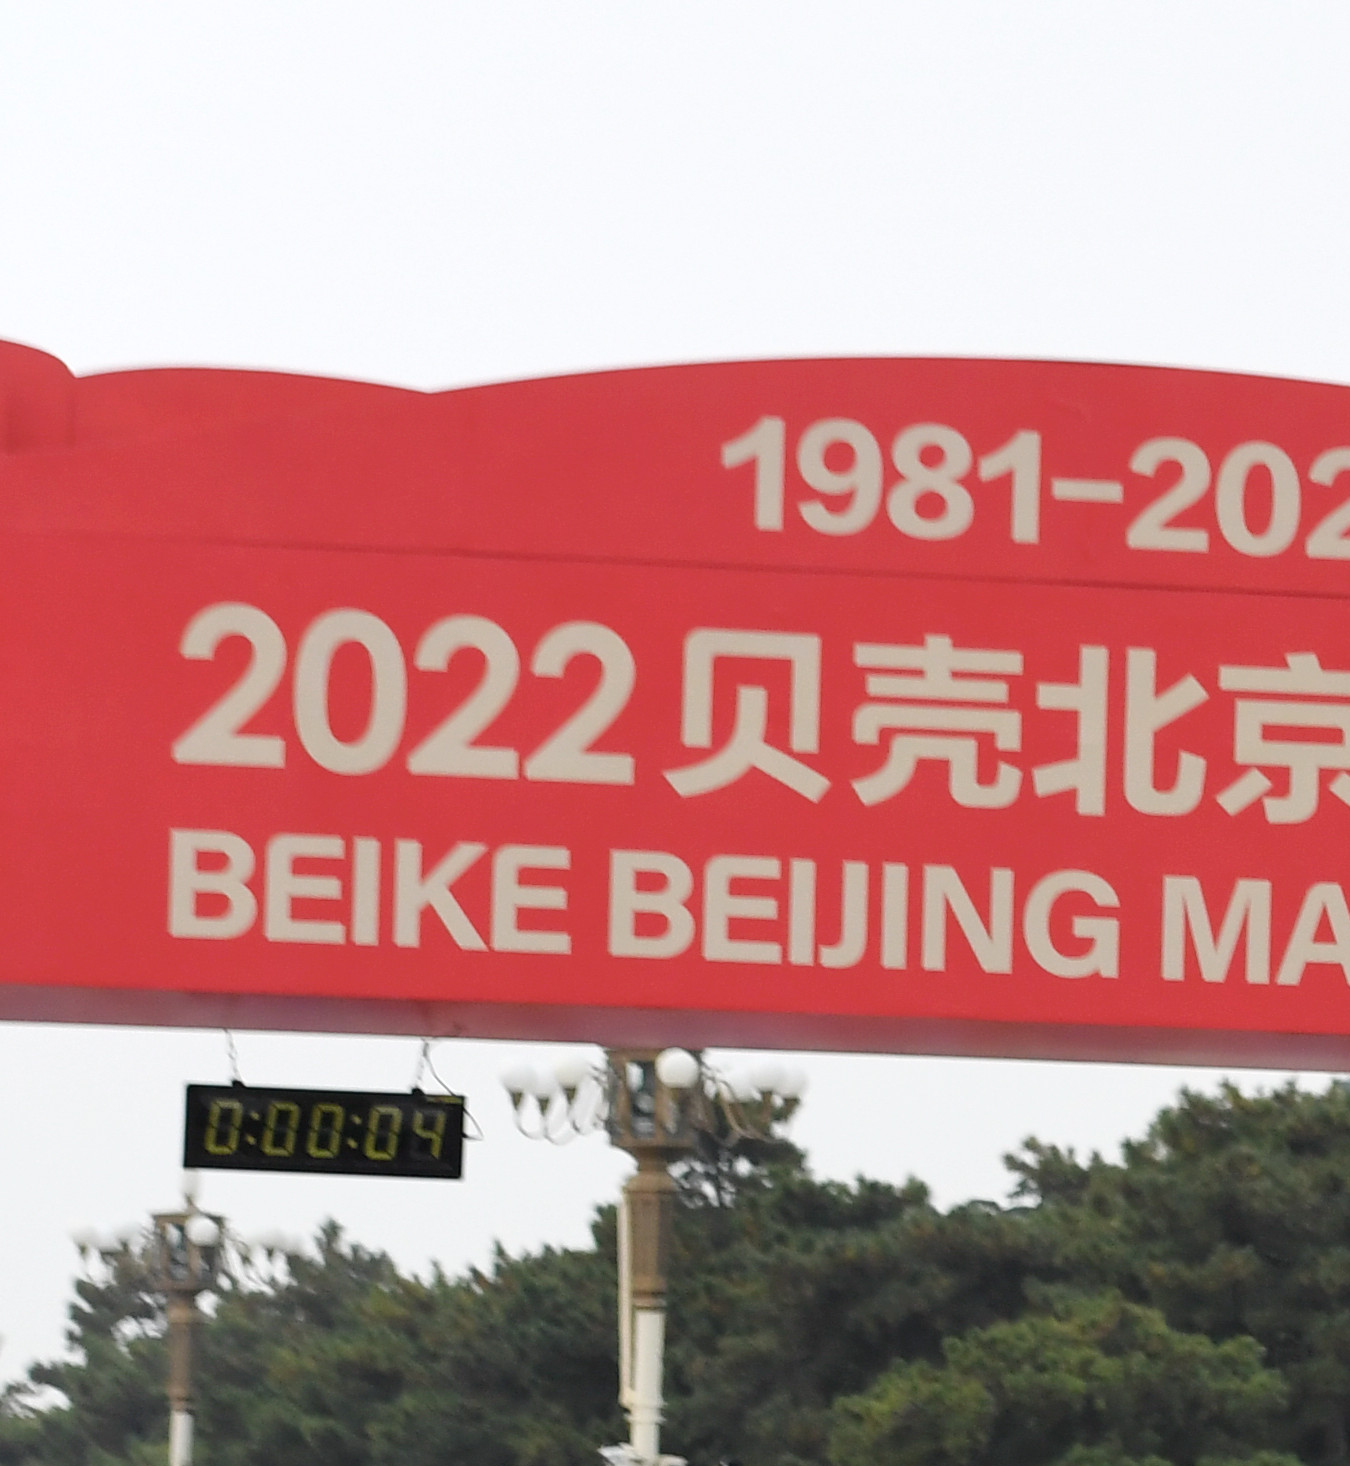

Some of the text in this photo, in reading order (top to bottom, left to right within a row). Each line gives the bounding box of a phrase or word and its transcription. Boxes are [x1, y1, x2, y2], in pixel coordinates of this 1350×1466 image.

[172, 602, 636, 785] 2022
[168, 828, 572, 956] BEIKE
[608, 849, 1121, 980] BEIJING
[204, 1098, 446, 1162] 0:00:04
